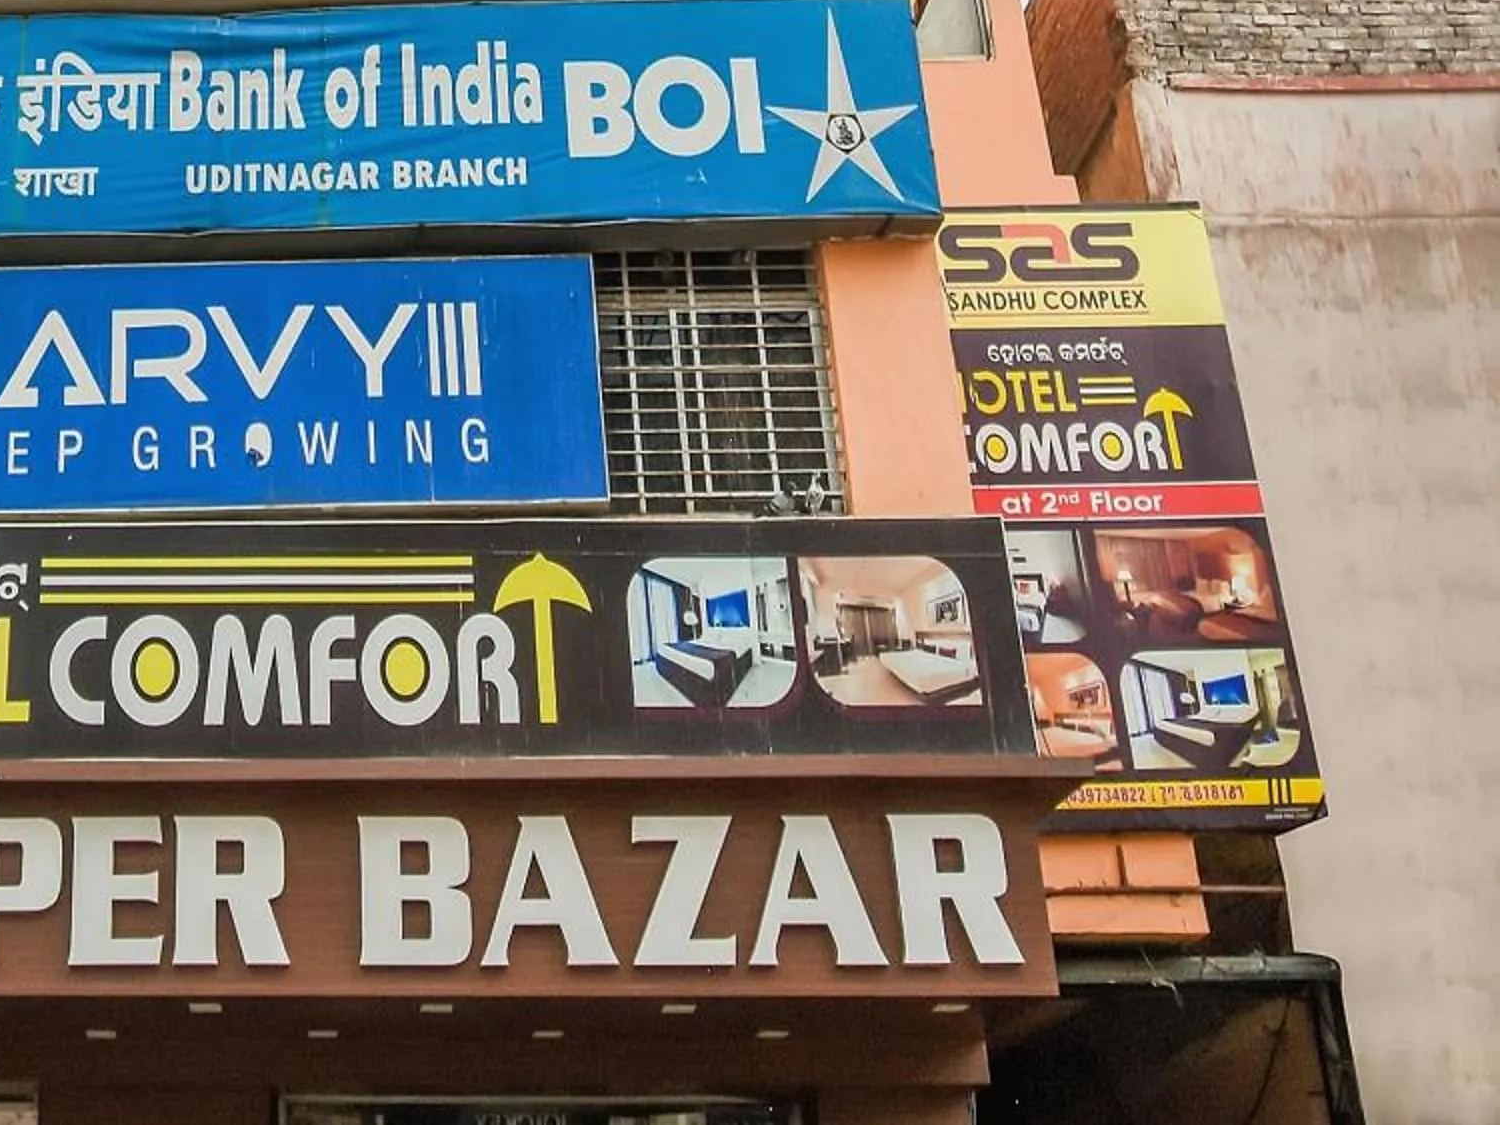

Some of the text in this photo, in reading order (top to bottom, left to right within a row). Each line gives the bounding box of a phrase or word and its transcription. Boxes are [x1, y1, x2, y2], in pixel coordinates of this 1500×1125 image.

[16, 52, 161, 146] इंडिया
[169, 40, 543, 132] Bank of India
[563, 55, 766, 158] BOI
[14, 166, 99, 198] शाखा
[185, 157, 527, 195] UDITNAGAR BRANCH
[948, 288, 1148, 313] SANDHU COMPLEX
[132, 418, 490, 472] GROWING
[1001, 490, 1163, 515] at 2nd Floor
[50, 552, 592, 727] COMFORT
[358, 813, 1026, 967] BAZAR
